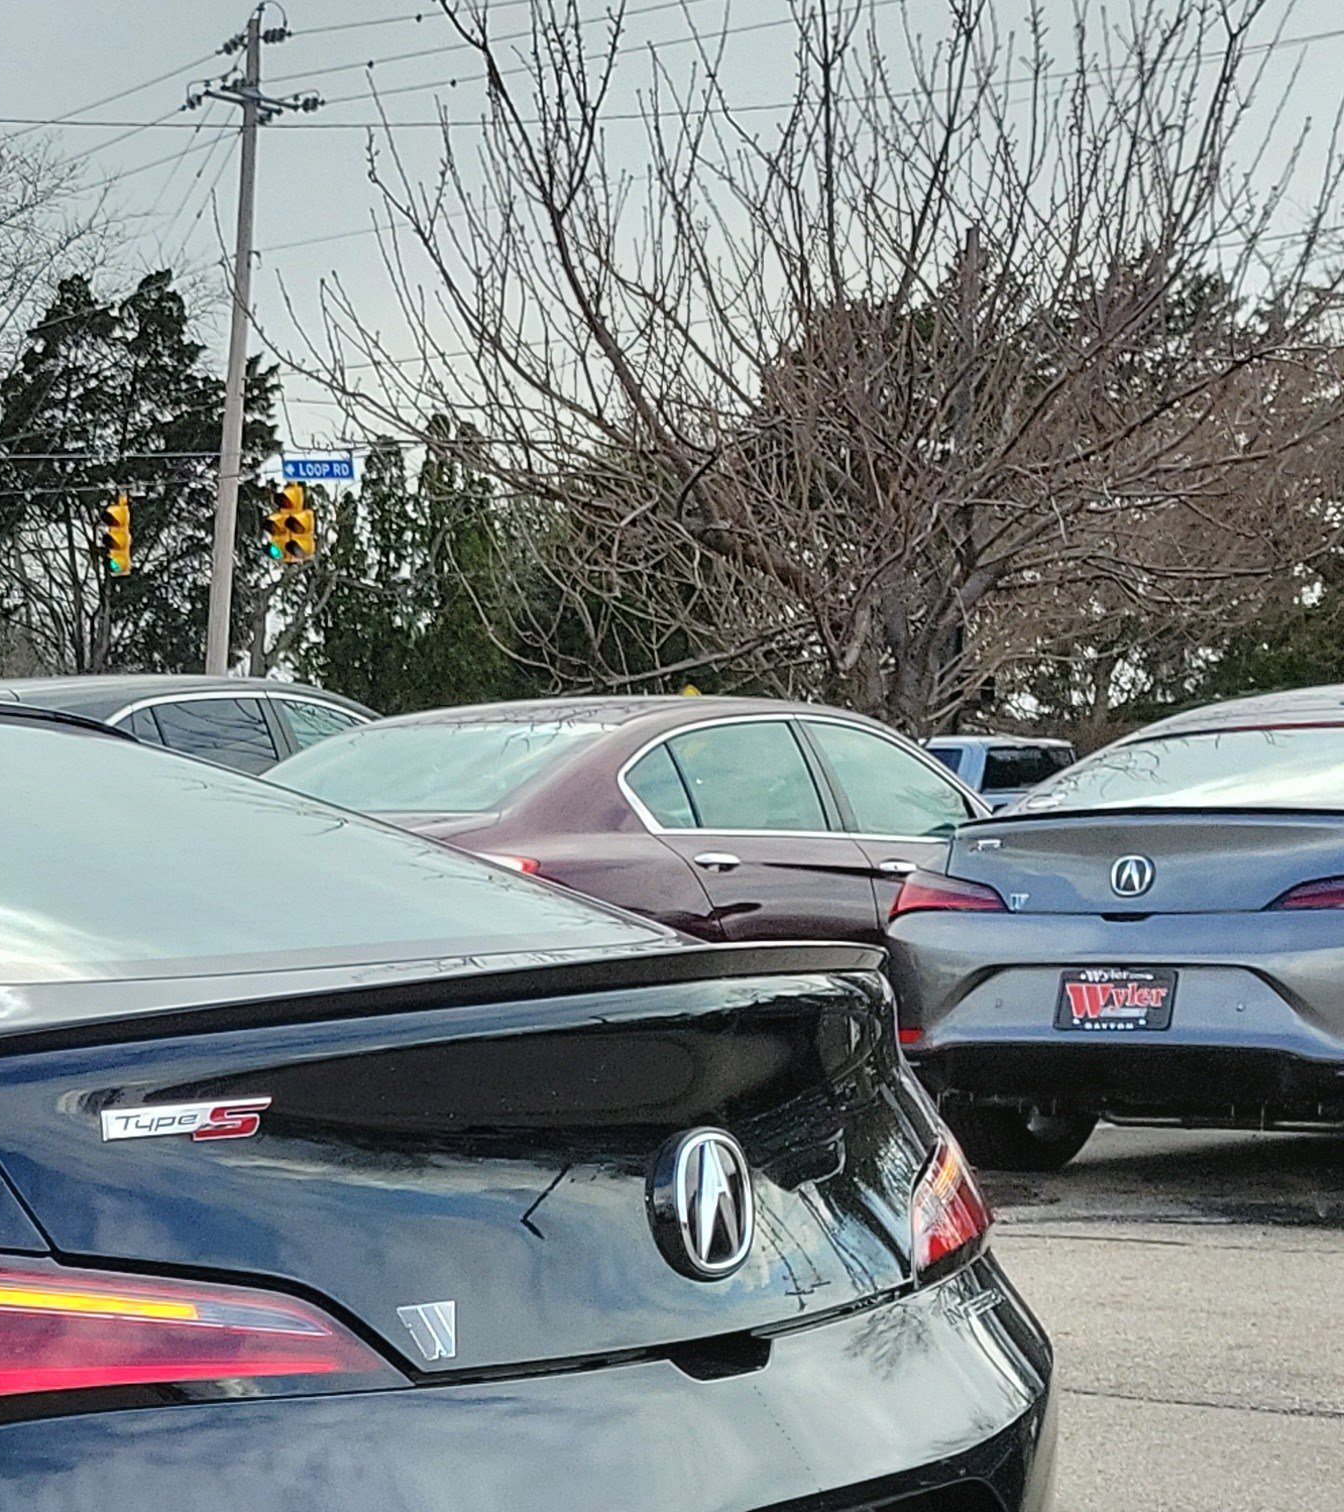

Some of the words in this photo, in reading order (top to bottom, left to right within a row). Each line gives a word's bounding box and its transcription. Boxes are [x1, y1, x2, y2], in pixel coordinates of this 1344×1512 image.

[298, 462, 330, 477] LOOP
[332, 463, 350, 477] RD
[1065, 982, 1168, 1019] Wyler
[114, 1114, 198, 1132] Type
[192, 1097, 273, 1142] S
